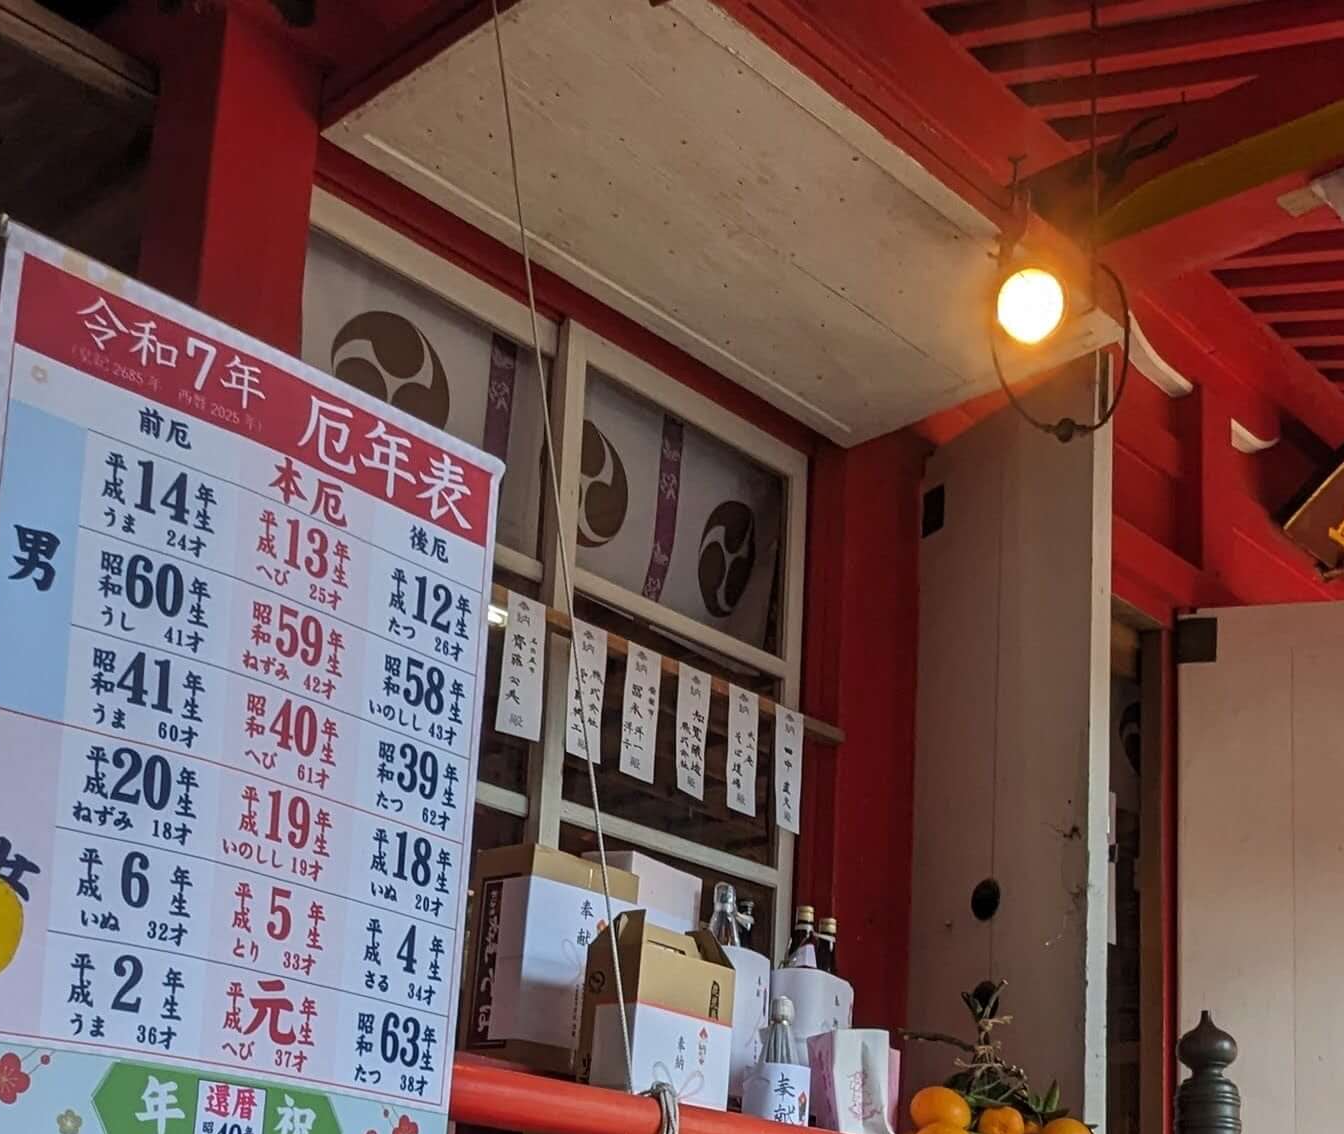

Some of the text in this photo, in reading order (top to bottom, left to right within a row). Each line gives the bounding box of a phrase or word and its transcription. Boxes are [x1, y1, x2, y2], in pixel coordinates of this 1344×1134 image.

[77, 297, 473, 530] 令和7年 厄年表
[138, 407, 192, 450] 前厄
[270, 458, 347, 528] 本厄
[103, 508, 207, 558] うま 24才
[409, 526, 449, 563] 後厄
[8, 524, 60, 592] 男
[257, 563, 341, 611] へび 25才
[100, 606, 204, 653] うし 41才
[389, 616, 464, 658] たつ 26才
[243, 652, 337, 699] ねずみ 42才
[92, 704, 199, 749] うま 60才
[370, 700, 456, 746] いのしし 43才
[245, 748, 329, 789] へび 61才
[73, 806, 192, 845] ねずみ 18才
[377, 792, 450, 831] たつ 62才
[222, 837, 323, 882] いのしし 19才
[371, 881, 444, 918] いぬ 20才
[81, 910, 187, 947] いぬ 32才
[232, 938, 316, 976] とり 33才
[365, 969, 436, 1004] さる 34才
[69, 1014, 177, 1051] うま 36才
[222, 1042, 308, 1073] へび 37才
[355, 1063, 428, 1096] たつ 38才
[204, 1083, 257, 1119] 還暦
